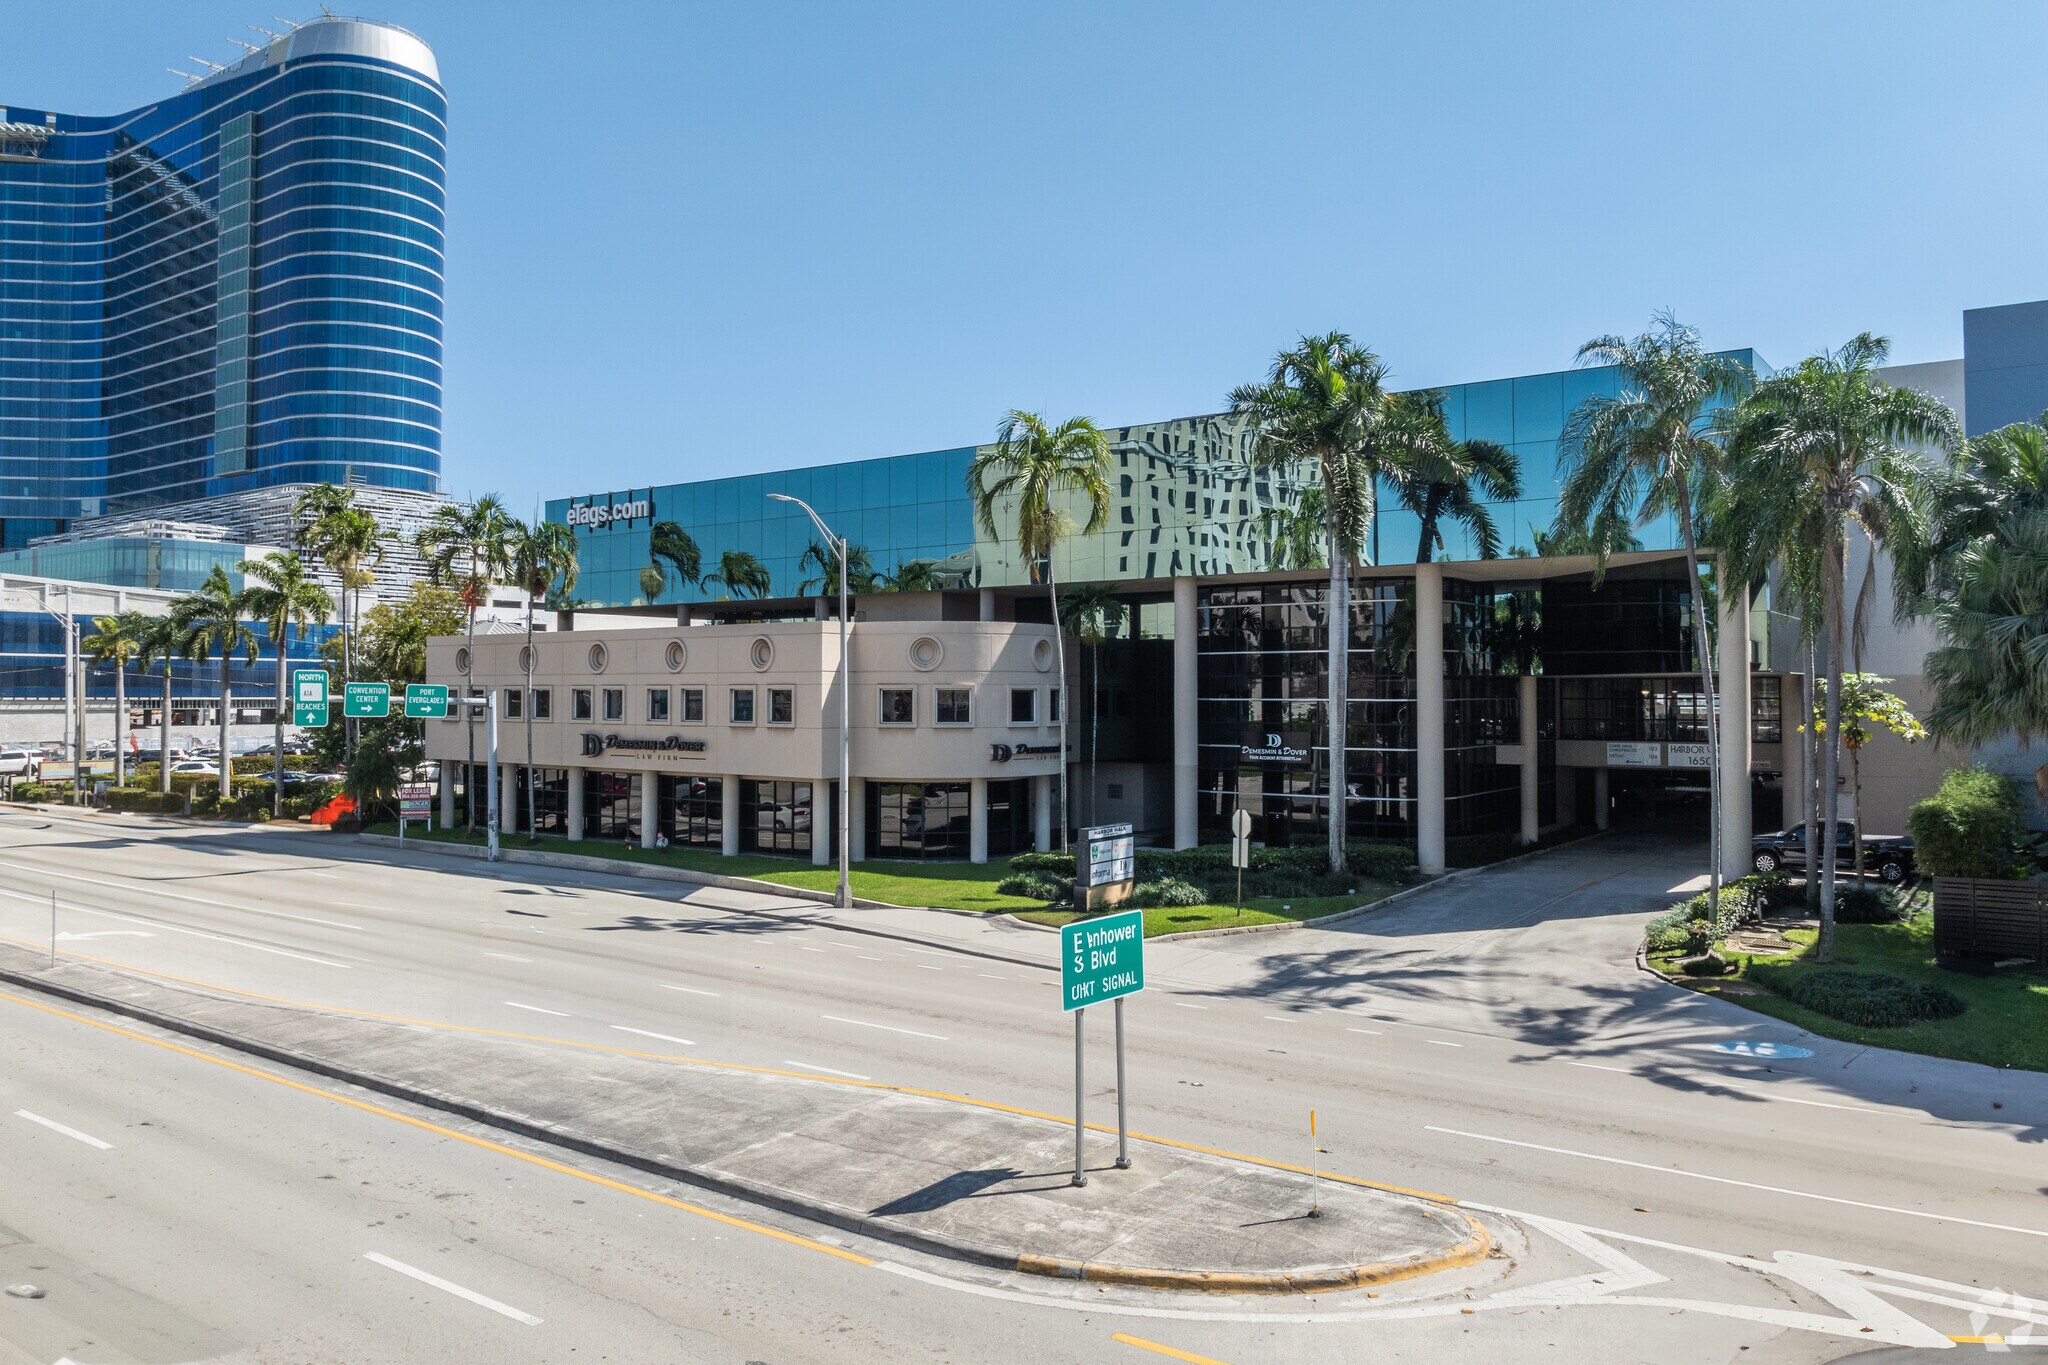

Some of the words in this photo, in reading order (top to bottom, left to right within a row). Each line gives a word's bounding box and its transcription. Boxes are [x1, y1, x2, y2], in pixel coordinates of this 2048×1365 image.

[566, 500, 650, 528] eTags.com
[348, 687, 387, 695] CONVENTION
[419, 688, 435, 696] PORT
[408, 696, 445, 704] EVERGLADES
[296, 703, 326, 711] BEACHES
[605, 734, 657, 751] DEMESMIN
[665, 736, 705, 752] DOVER
[1241, 746, 1276, 755] DEMESMIN
[1283, 747, 1308, 756] DOVER
[1670, 745, 1705, 754] HARBOR
[1091, 946, 1116, 970] Blvd
[1102, 970, 1138, 992] SIGNAL
